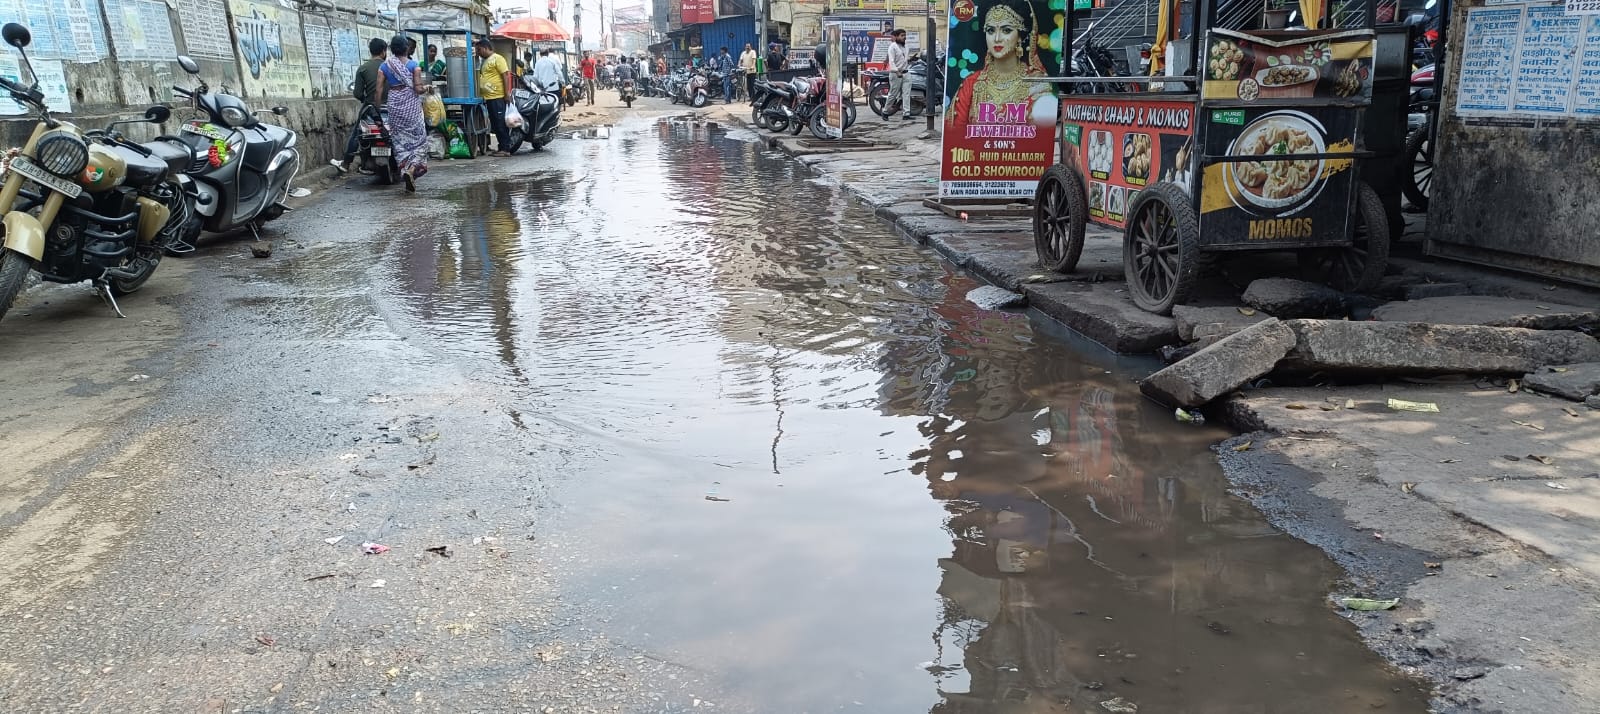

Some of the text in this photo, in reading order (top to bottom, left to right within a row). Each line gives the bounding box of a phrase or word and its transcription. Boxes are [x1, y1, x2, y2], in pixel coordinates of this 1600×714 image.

[1484, 22, 1499, 30] SEX
[1541, 19, 1559, 27] SEX
[1065, 104, 1190, 128] MOTHER'S CHAAP & MOMOS
[965, 124, 1037, 139] JEWELLERS
[984, 140, 1016, 150] & SON'S
[951, 147, 975, 163] 100%
[1002, 152, 1045, 162] HALLMARK
[952, 165, 1044, 177] GOLD SHOWROOM
[1248, 218, 1313, 240] MOMOS
